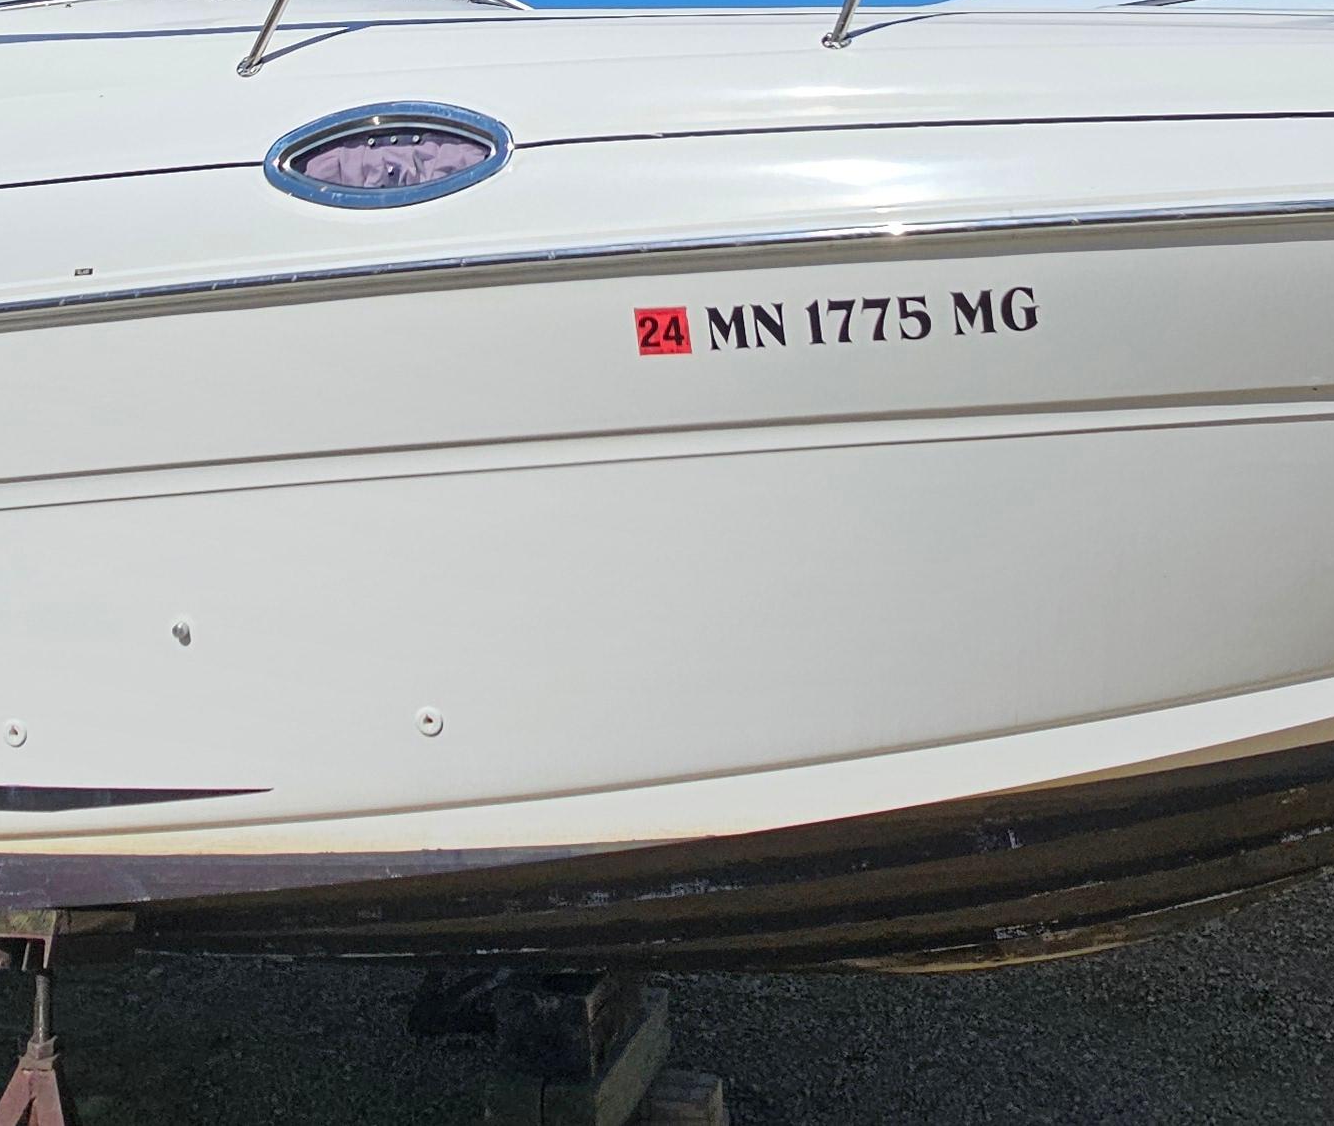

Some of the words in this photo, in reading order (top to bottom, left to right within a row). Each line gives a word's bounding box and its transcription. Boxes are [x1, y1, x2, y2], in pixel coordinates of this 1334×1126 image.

[638, 315, 685, 348] 24
[705, 302, 788, 351] MN
[805, 295, 932, 346] 1775
[950, 286, 1041, 336] MG
